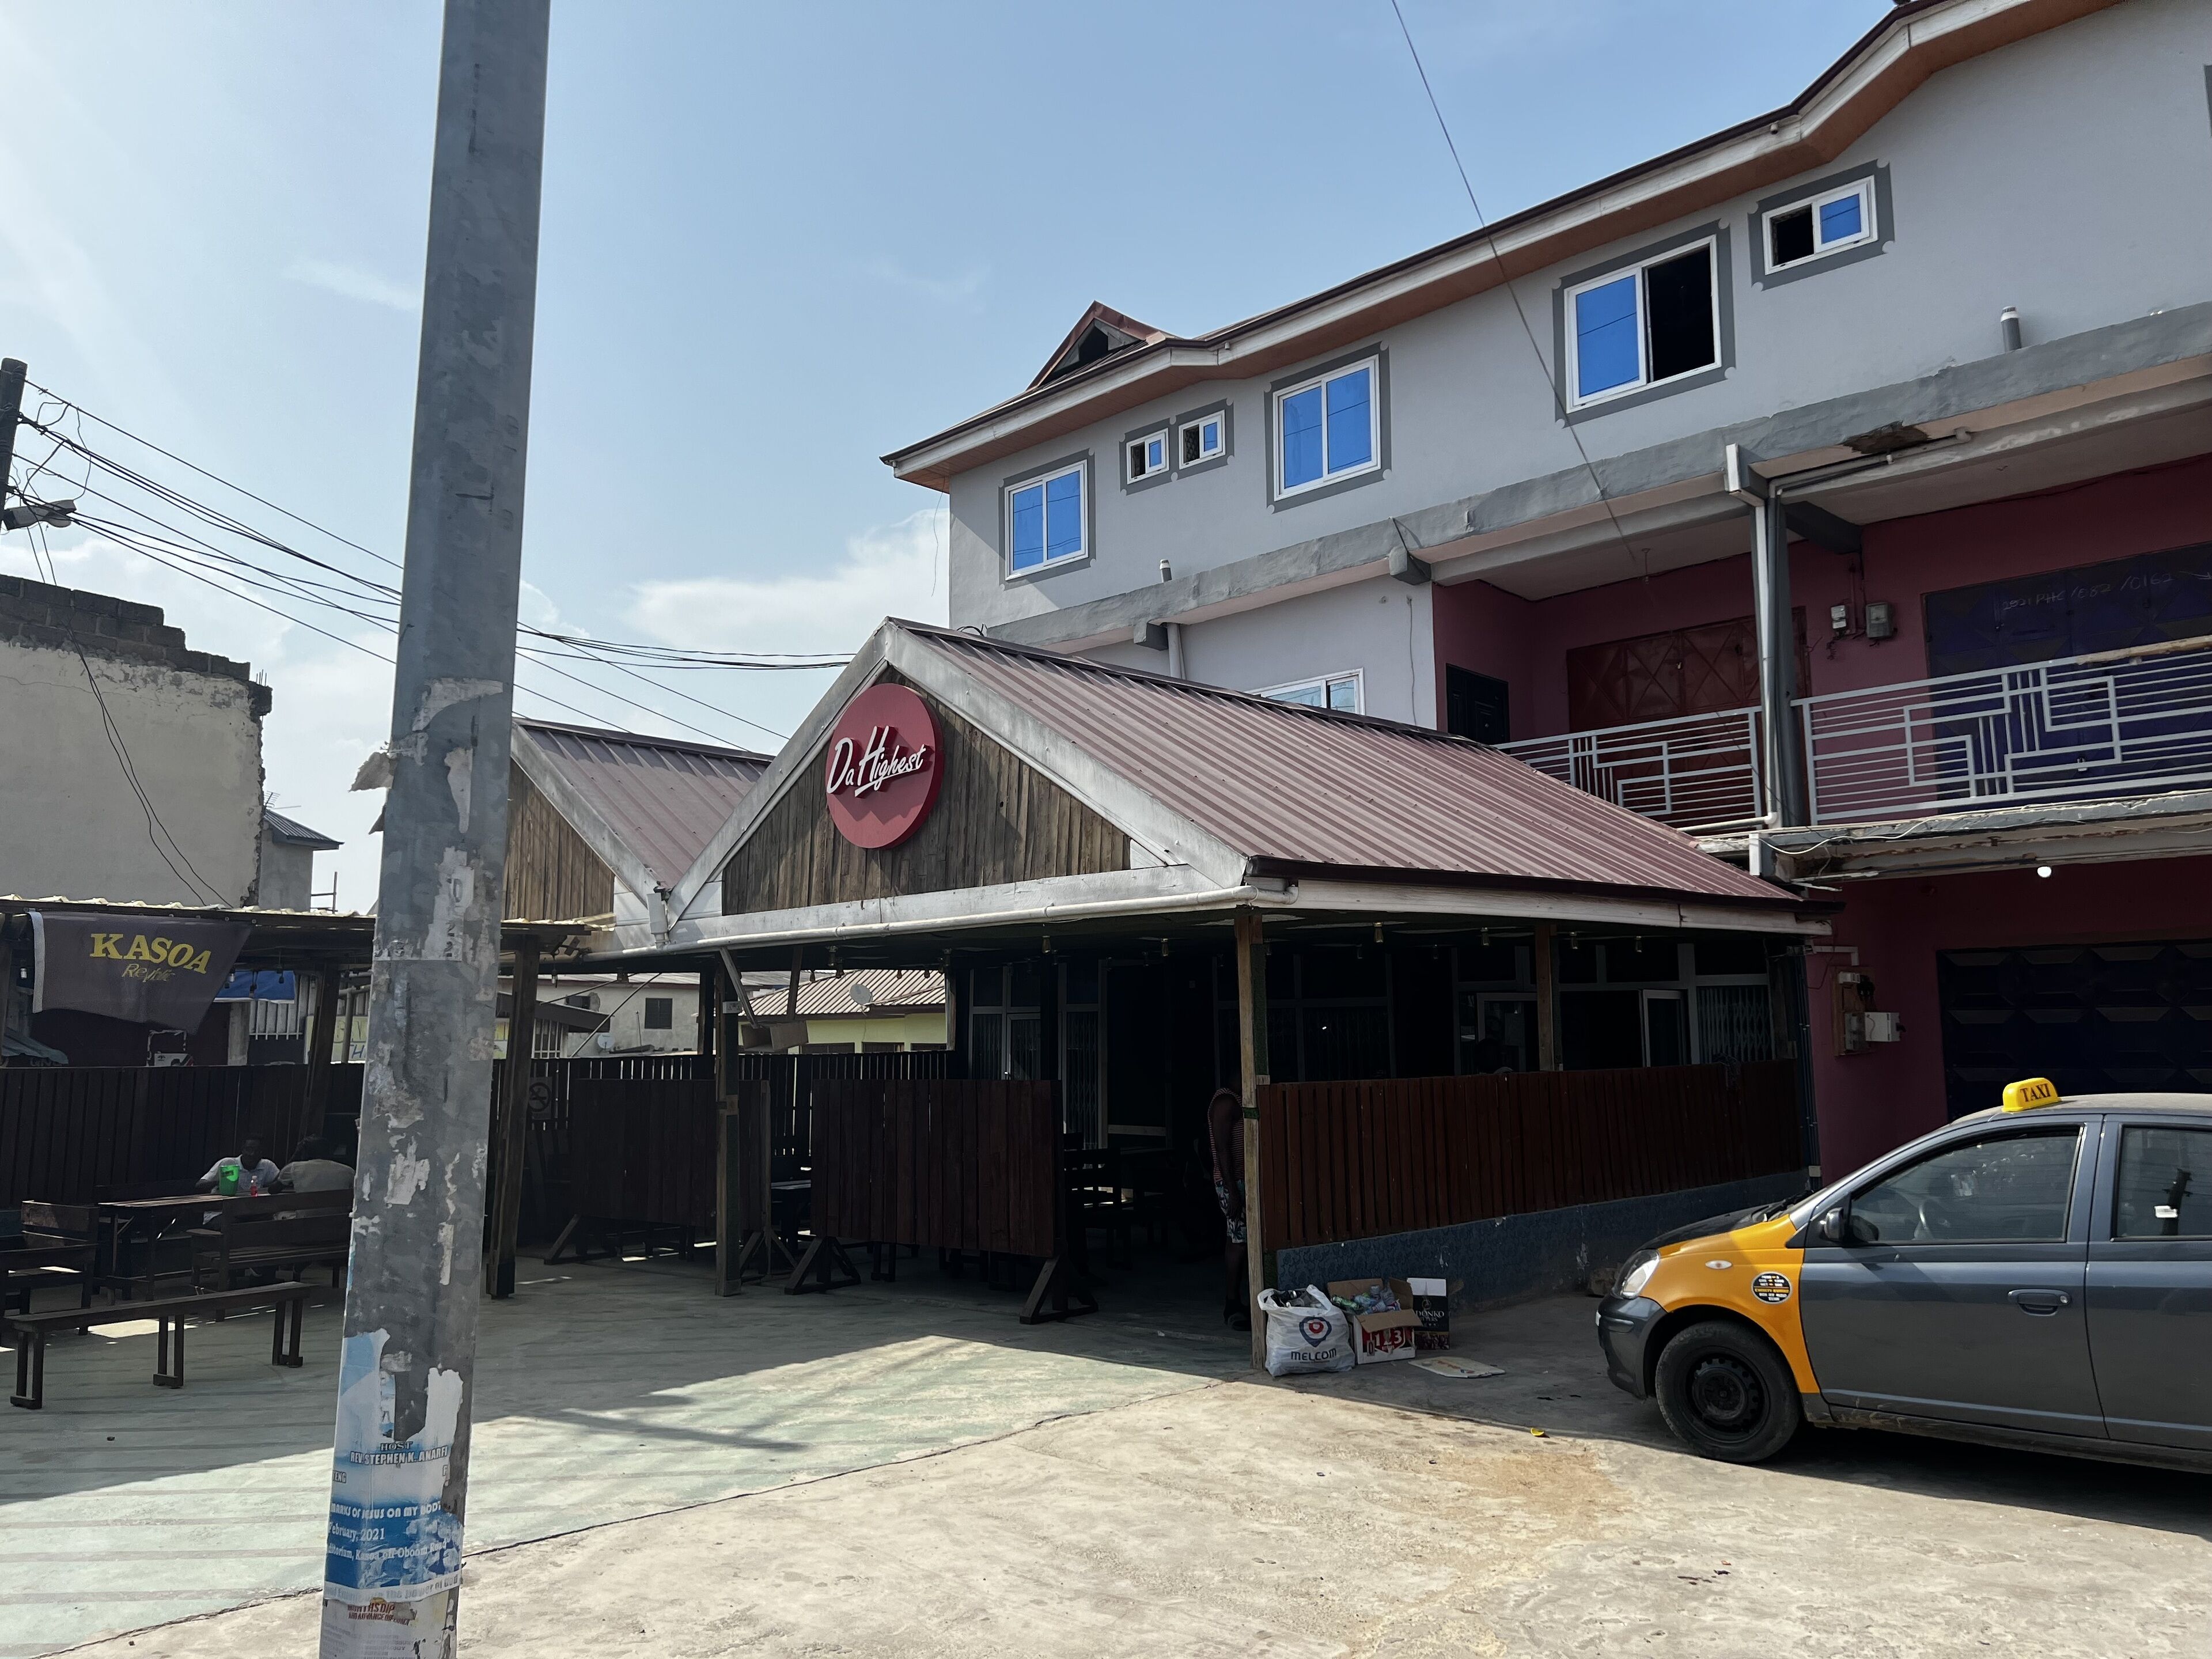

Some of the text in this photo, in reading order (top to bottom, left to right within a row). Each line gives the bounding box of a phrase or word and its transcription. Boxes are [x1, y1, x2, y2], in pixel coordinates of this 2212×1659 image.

[827, 726, 926, 797] Da Highest
[90, 933, 211, 975] KASOA
[2020, 1083, 2051, 1102] TAXI
[1290, 1348, 1337, 1361] MELCOM
[380, 1441, 413, 1451] HOST
[363, 1452, 406, 1465] STEPHEN
[403, 1506, 418, 1517] MY
[359, 1527, 385, 1541] 2021
